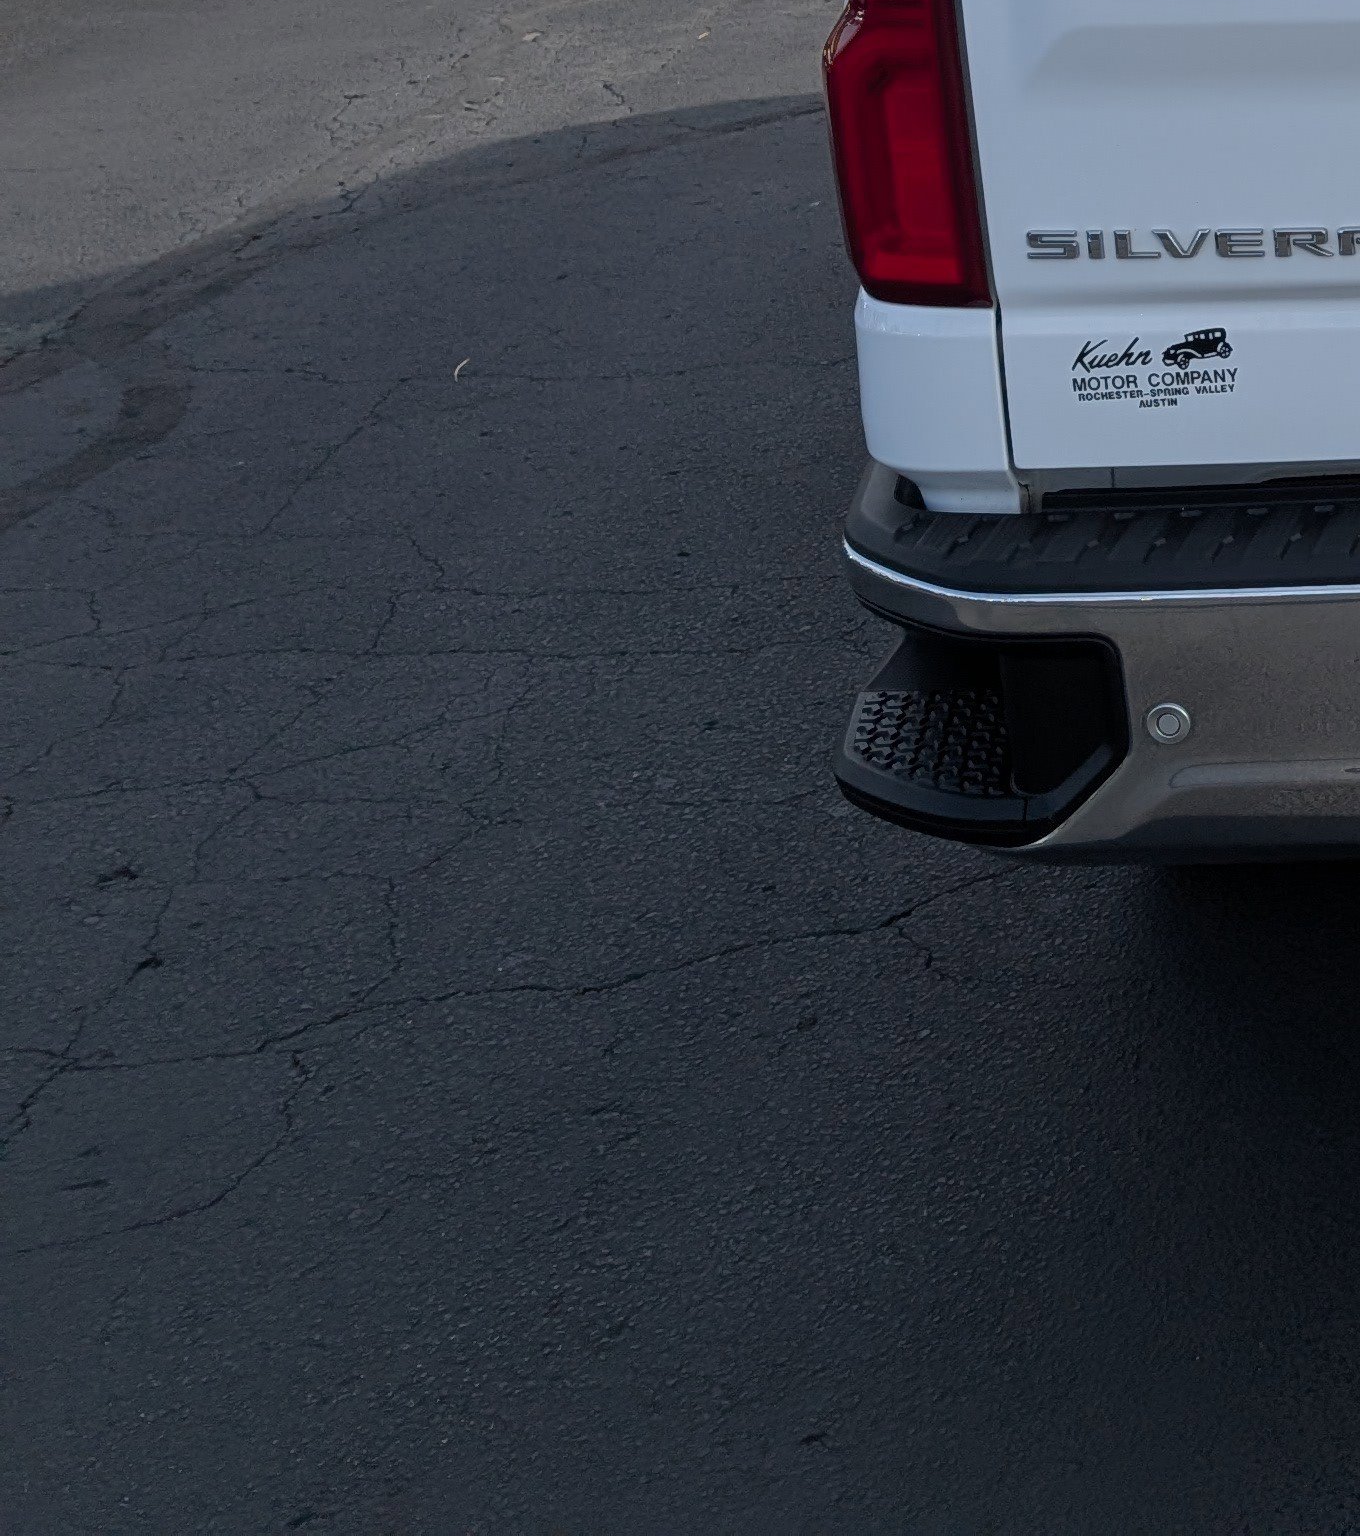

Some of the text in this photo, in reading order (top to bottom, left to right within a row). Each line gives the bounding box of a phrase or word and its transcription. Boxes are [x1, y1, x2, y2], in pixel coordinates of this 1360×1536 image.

[1072, 337, 1153, 373] Kuehn
[1072, 368, 1238, 392] MOTOR COMPANY
[1078, 383, 1235, 402] ROCHESTER-SPRING VALLEY
[1138, 398, 1178, 409] AUSTIN
